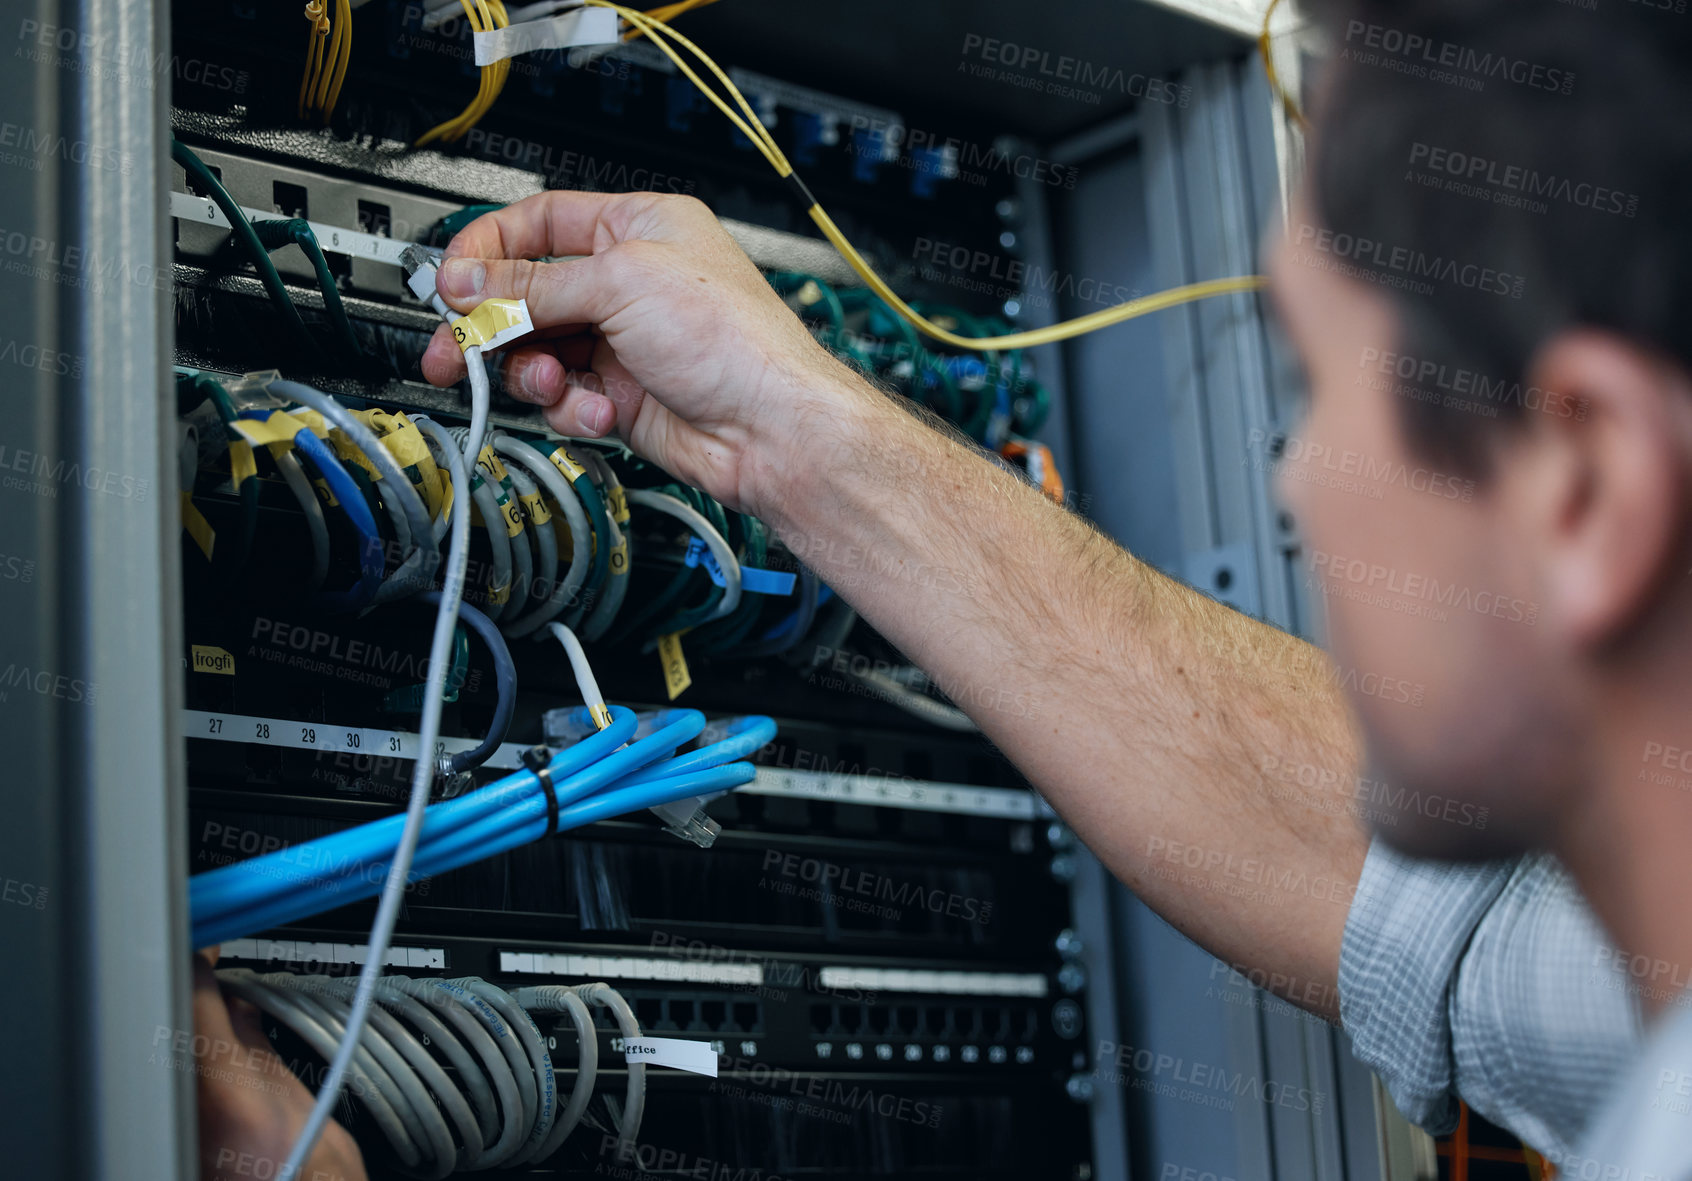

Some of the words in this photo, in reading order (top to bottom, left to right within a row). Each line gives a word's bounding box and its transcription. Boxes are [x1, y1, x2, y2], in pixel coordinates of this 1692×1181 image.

[207, 205, 215, 219] 3
[331, 231, 340, 247] 6
[453, 327, 466, 344] 3
[195, 651, 231, 671] frogfi
[209, 718, 223, 734] 27
[256, 723, 270, 740] 28
[301, 727, 316, 744] 29
[346, 732, 360, 748] 30
[389, 736, 401, 752] 31
